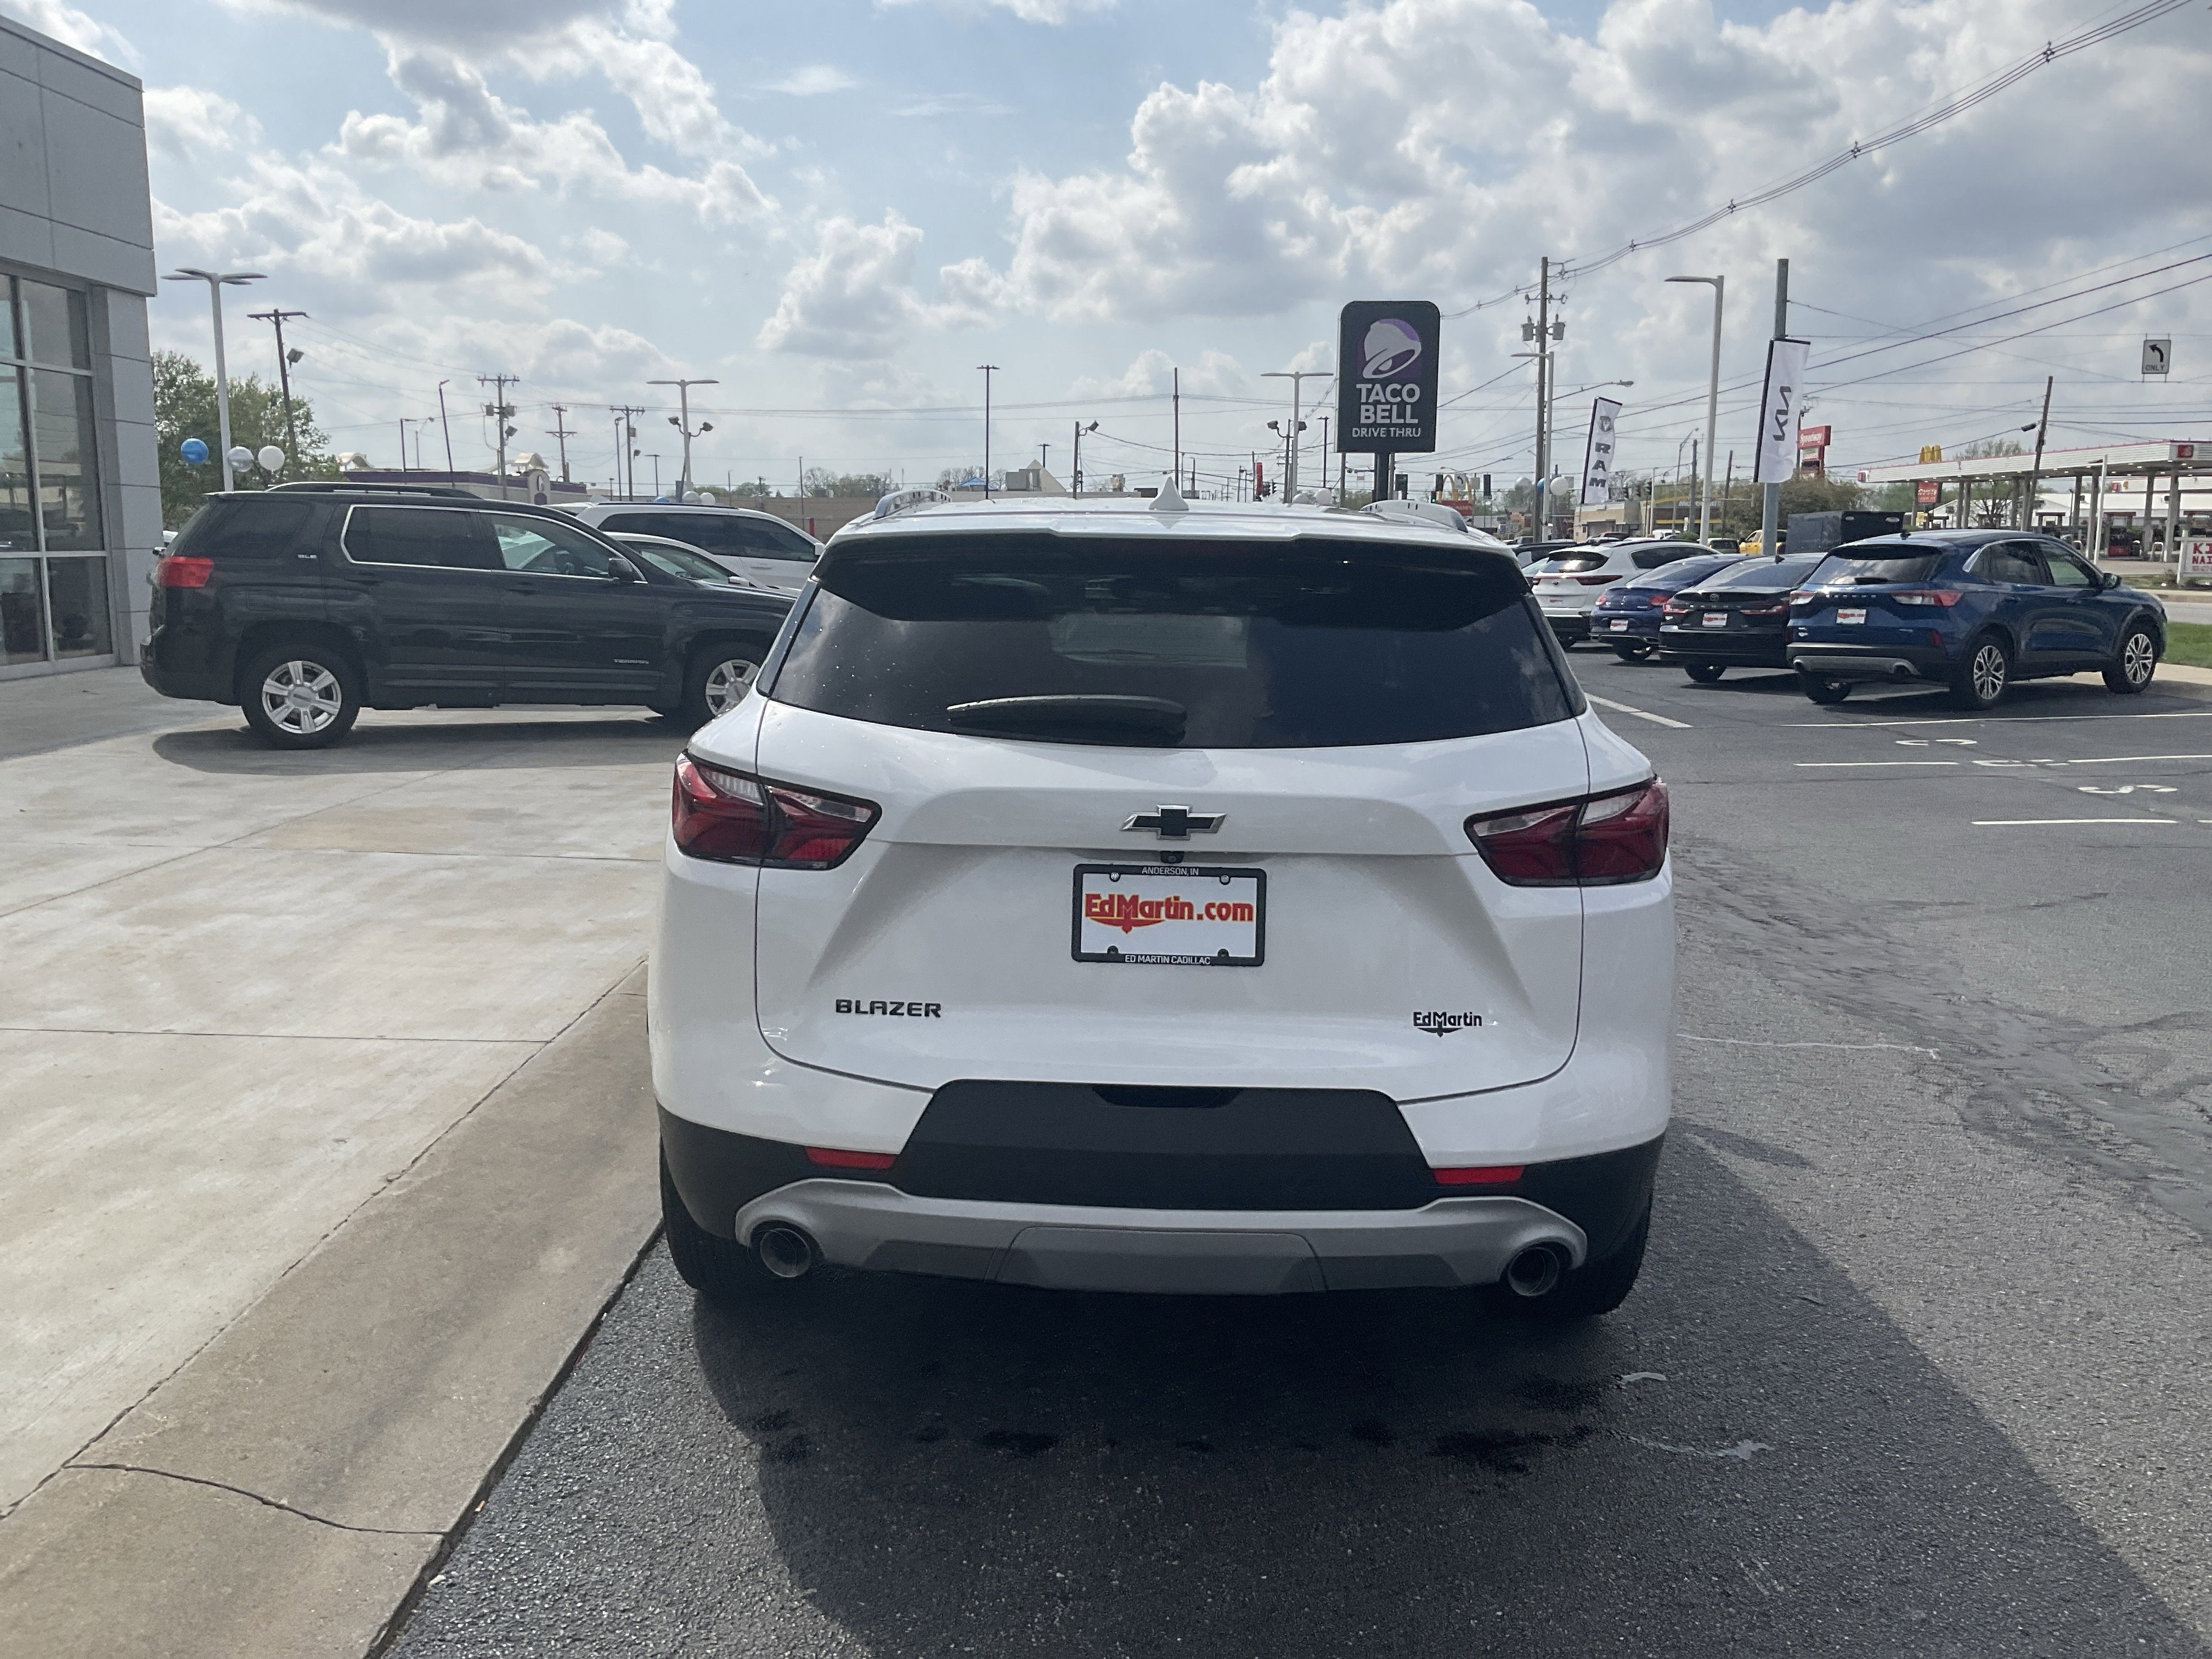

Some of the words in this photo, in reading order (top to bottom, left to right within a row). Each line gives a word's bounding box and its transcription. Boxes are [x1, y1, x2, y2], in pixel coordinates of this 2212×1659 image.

[1356, 383, 1420, 403] TACO
[1360, 404, 1418, 424] BELL
[1352, 427, 1386, 437] DRIVE
[1389, 427, 1421, 437] THRU
[1589, 442, 1611, 488] RAM
[1141, 866, 1189, 876] ANDERSON,
[1190, 867, 1199, 876] IN
[1085, 893, 1254, 923] EdMartin.com
[1137, 955, 1169, 963] MARTIN
[1171, 956, 1210, 964] CADILLAC
[836, 999, 941, 1018] BLAZER
[1413, 1011, 1482, 1027] EdMartin
